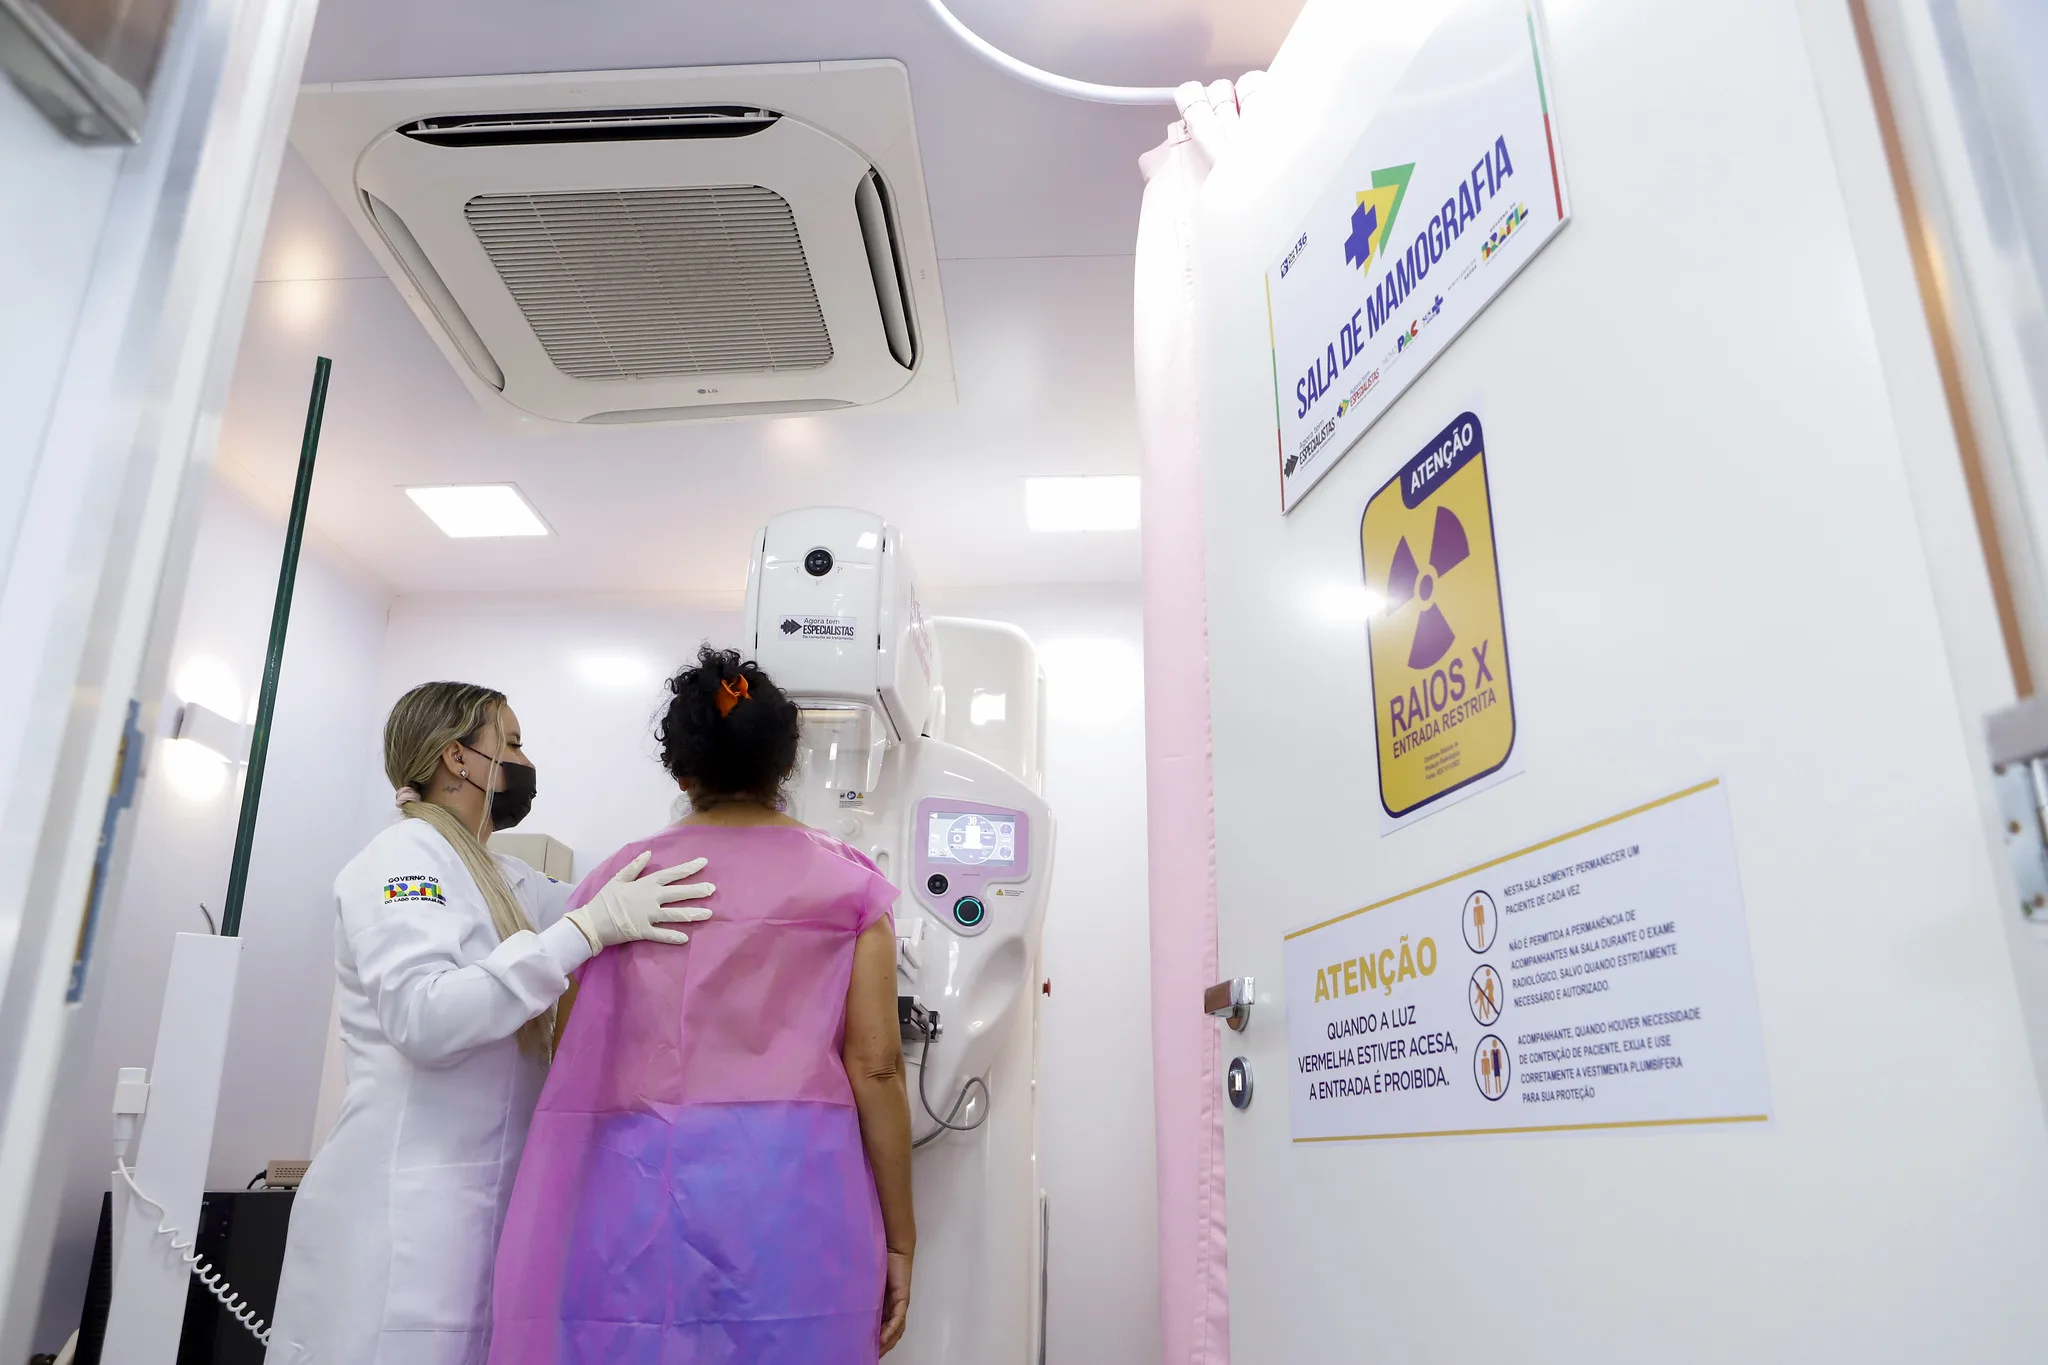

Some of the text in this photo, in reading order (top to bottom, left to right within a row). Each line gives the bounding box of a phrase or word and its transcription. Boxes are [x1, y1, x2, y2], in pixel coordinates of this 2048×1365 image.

[1295, 231, 1307, 255] 136
[1481, 202, 1529, 262] BRASIL
[1296, 342, 1339, 420] SALA
[1340, 307, 1365, 370] DE
[1366, 134, 1514, 339] MAMOGRAFIA
[1397, 319, 1418, 351] PAC
[1349, 368, 1380, 408] ESPECIALISTAS
[1299, 417, 1336, 466] ESPECIALISTAS
[1411, 422, 1473, 494] ATENÇÃO
[803, 624, 855, 636] ESPECIALISTAS
[804, 617, 824, 626] Agora
[1390, 639, 1494, 738] RAIOS X
[1393, 719, 1441, 760] ENTRADA
[1442, 687, 1497, 732] RESTRITA
[388, 875, 439, 884] GOVERNO DO
[1503, 844, 1640, 897] NESTA SALA SOMENTE PERMANECER UM
[383, 882, 447, 902] BRASIL
[1505, 883, 1580, 915] PACIENTE DE CADA VEZ
[1508, 909, 1636, 952] NÃO É PERMITIDA A PERMANÊNCIA DE
[1511, 921, 1676, 970] ACOMPANHANTES NA SALA DURANTE O EXAME
[1314, 933, 1437, 1004] ATENÇÃO
[1559, 964, 1583, 979] SALVO
[1584, 957, 1616, 974] QUANDO
[1617, 943, 1678, 967] ESTRITAMENTE
[1514, 989, 1555, 1007] NECESSÁRIO
[1556, 988, 1561, 1000] E
[1327, 1005, 1416, 1040] QUANDO A LUZ
[1574, 1022, 1607, 1037] QUANDO
[1608, 1016, 1641, 1032] HOUVER
[1641, 1007, 1702, 1027] NECESSIDADE
[1298, 1031, 1458, 1073] VERMELHA ESTIVER ACESA,
[1518, 1053, 1528, 1065] DE
[1529, 1046, 1571, 1063] CONTENÇÃO
[1572, 1046, 1582, 1058] DE
[1623, 1037, 1646, 1052] EXIJA
[1647, 1036, 1653, 1049] E
[1654, 1034, 1672, 1048] USE
[1309, 1066, 1450, 1101] A ENTRADA É PROIBIDA.
[1520, 1055, 1683, 1084] CORRETAMENTE A VESTIMENTA PLUMBÍFERA
[1522, 1084, 1596, 1104] PARA SUA PROTEÇÃO
